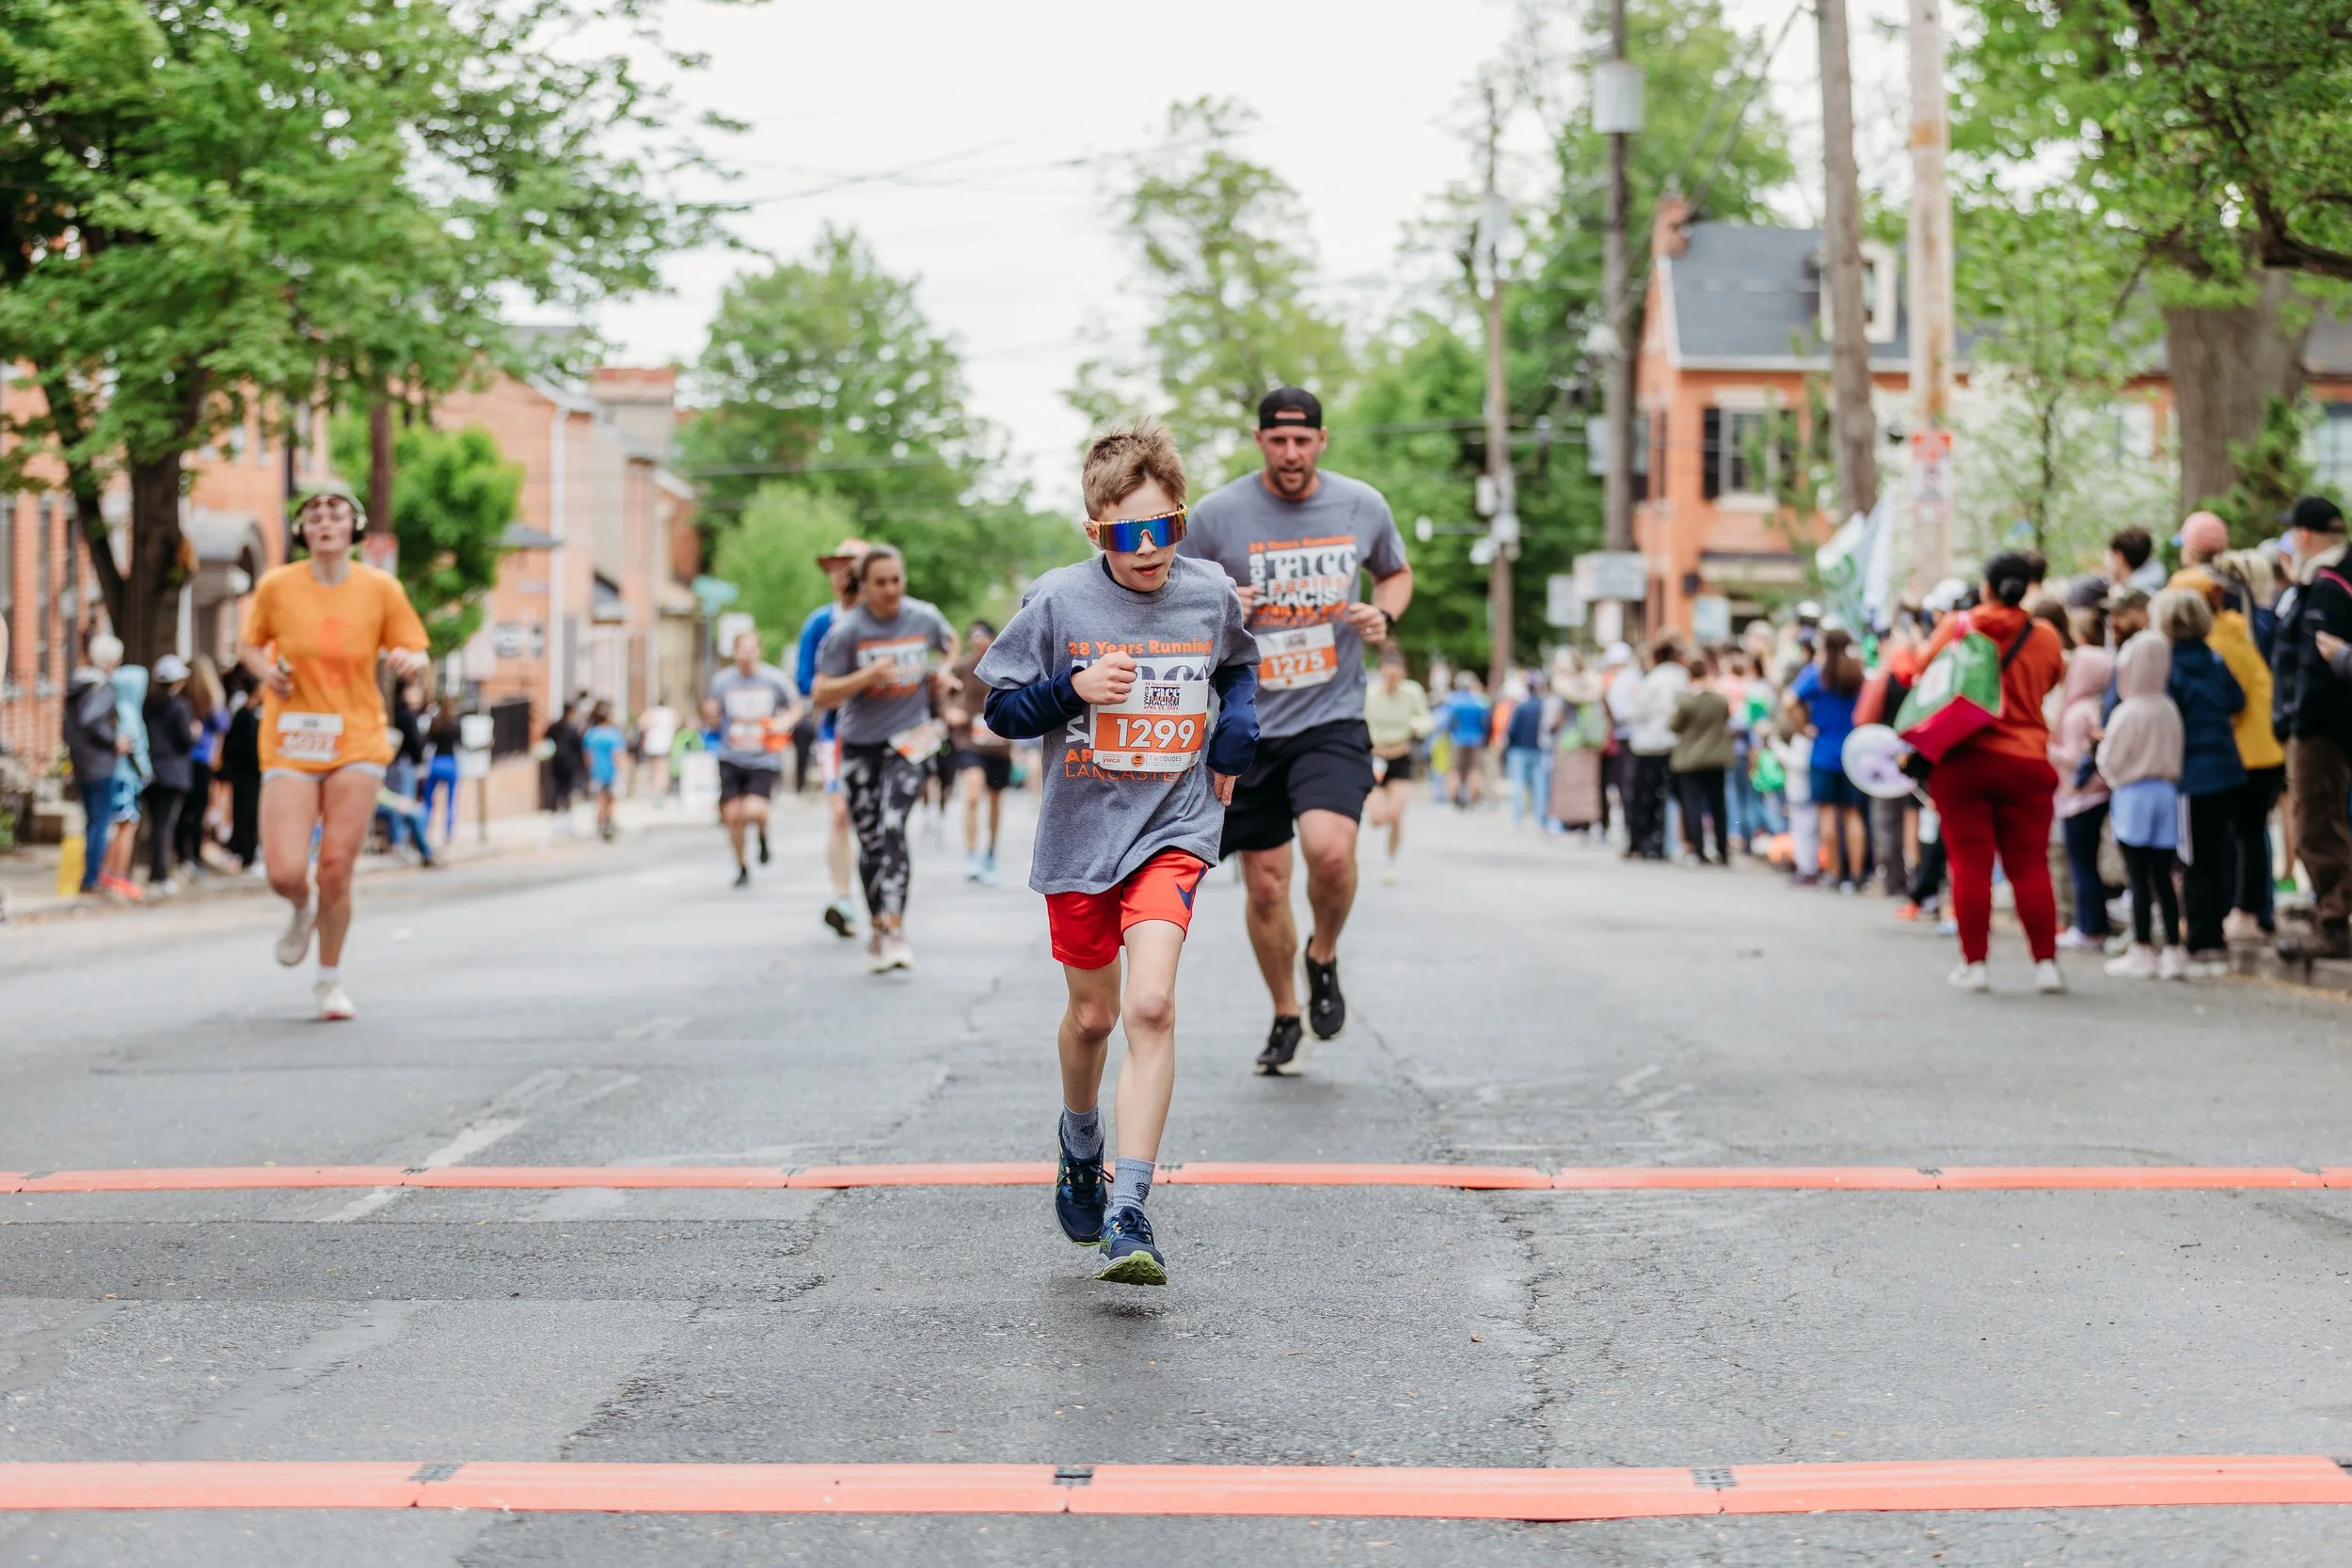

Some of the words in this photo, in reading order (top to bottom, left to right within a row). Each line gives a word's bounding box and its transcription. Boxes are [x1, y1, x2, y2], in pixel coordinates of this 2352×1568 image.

[1264, 551, 1357, 579] race
[1068, 641, 1090, 657] 28
[1095, 641, 1145, 656] Years
[1270, 650, 1326, 676] 1275
[1151, 687, 1181, 697] race
[1116, 718, 1196, 749] 1299
[1065, 763, 1183, 783] LANCASTE
